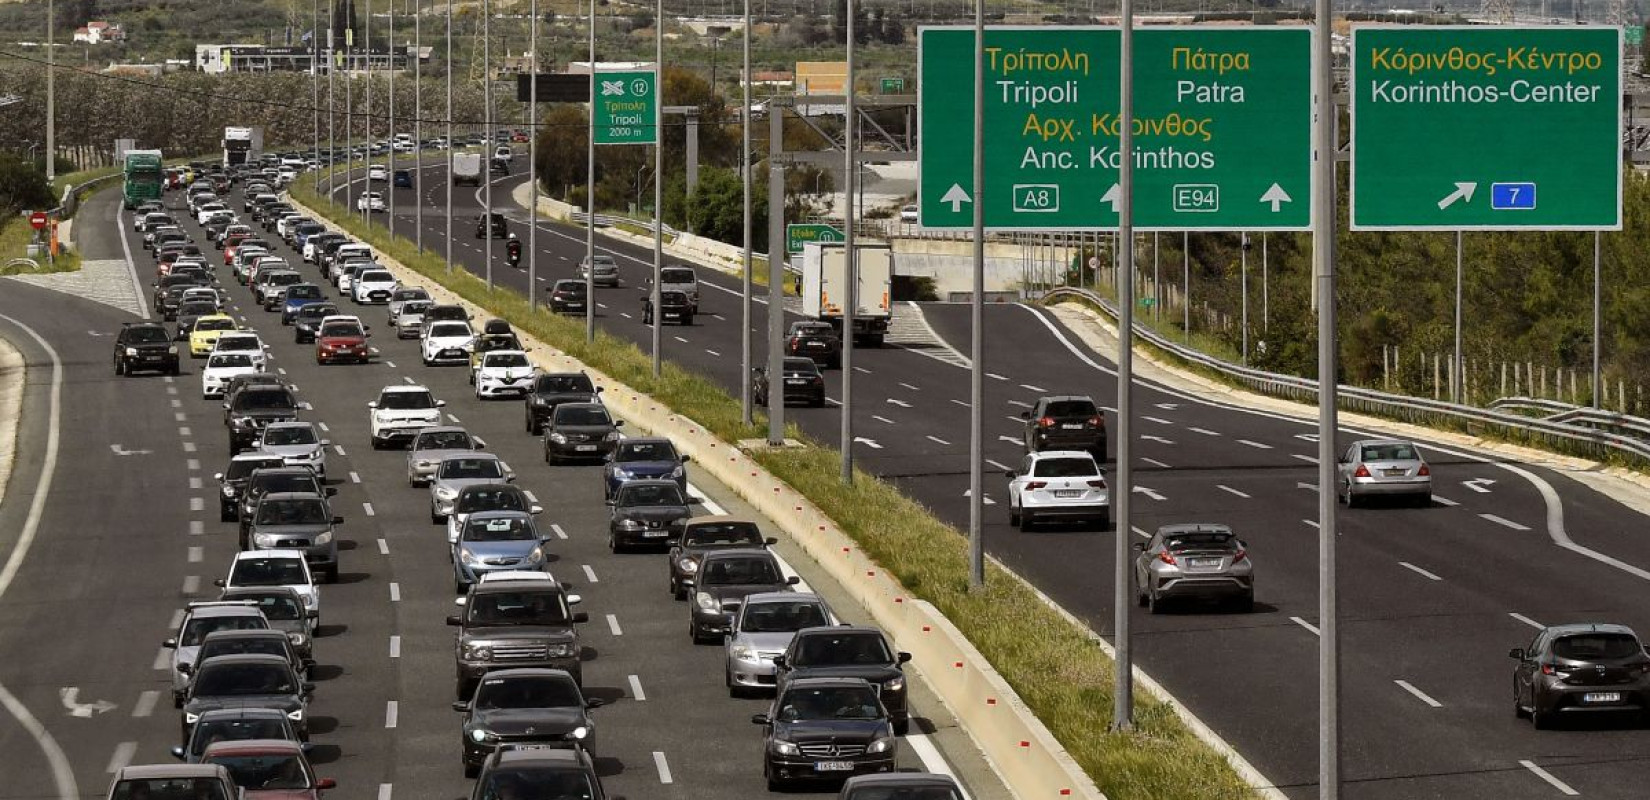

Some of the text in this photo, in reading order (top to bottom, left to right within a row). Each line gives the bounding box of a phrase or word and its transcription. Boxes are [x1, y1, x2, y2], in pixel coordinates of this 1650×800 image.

[985, 48, 1089, 76] Τρίπολη
[1173, 48, 1250, 75] Πάτρα
[1371, 47, 1602, 76] Κόρινθος-Κέντρο
[634, 82, 645, 93] 12
[996, 80, 1078, 108] Tripoli
[1177, 80, 1245, 103] Patra
[1371, 80, 1601, 103] Korinthos-Center
[609, 113, 642, 126] Tripoli
[1022, 113, 1081, 142] Αρχ.
[609, 127, 642, 137] 2000 m
[1020, 146, 1215, 169] Anc. Kointhos
[1024, 190, 1049, 207] A8
[1179, 190, 1215, 207] E94
[1509, 187, 1520, 204] 7
